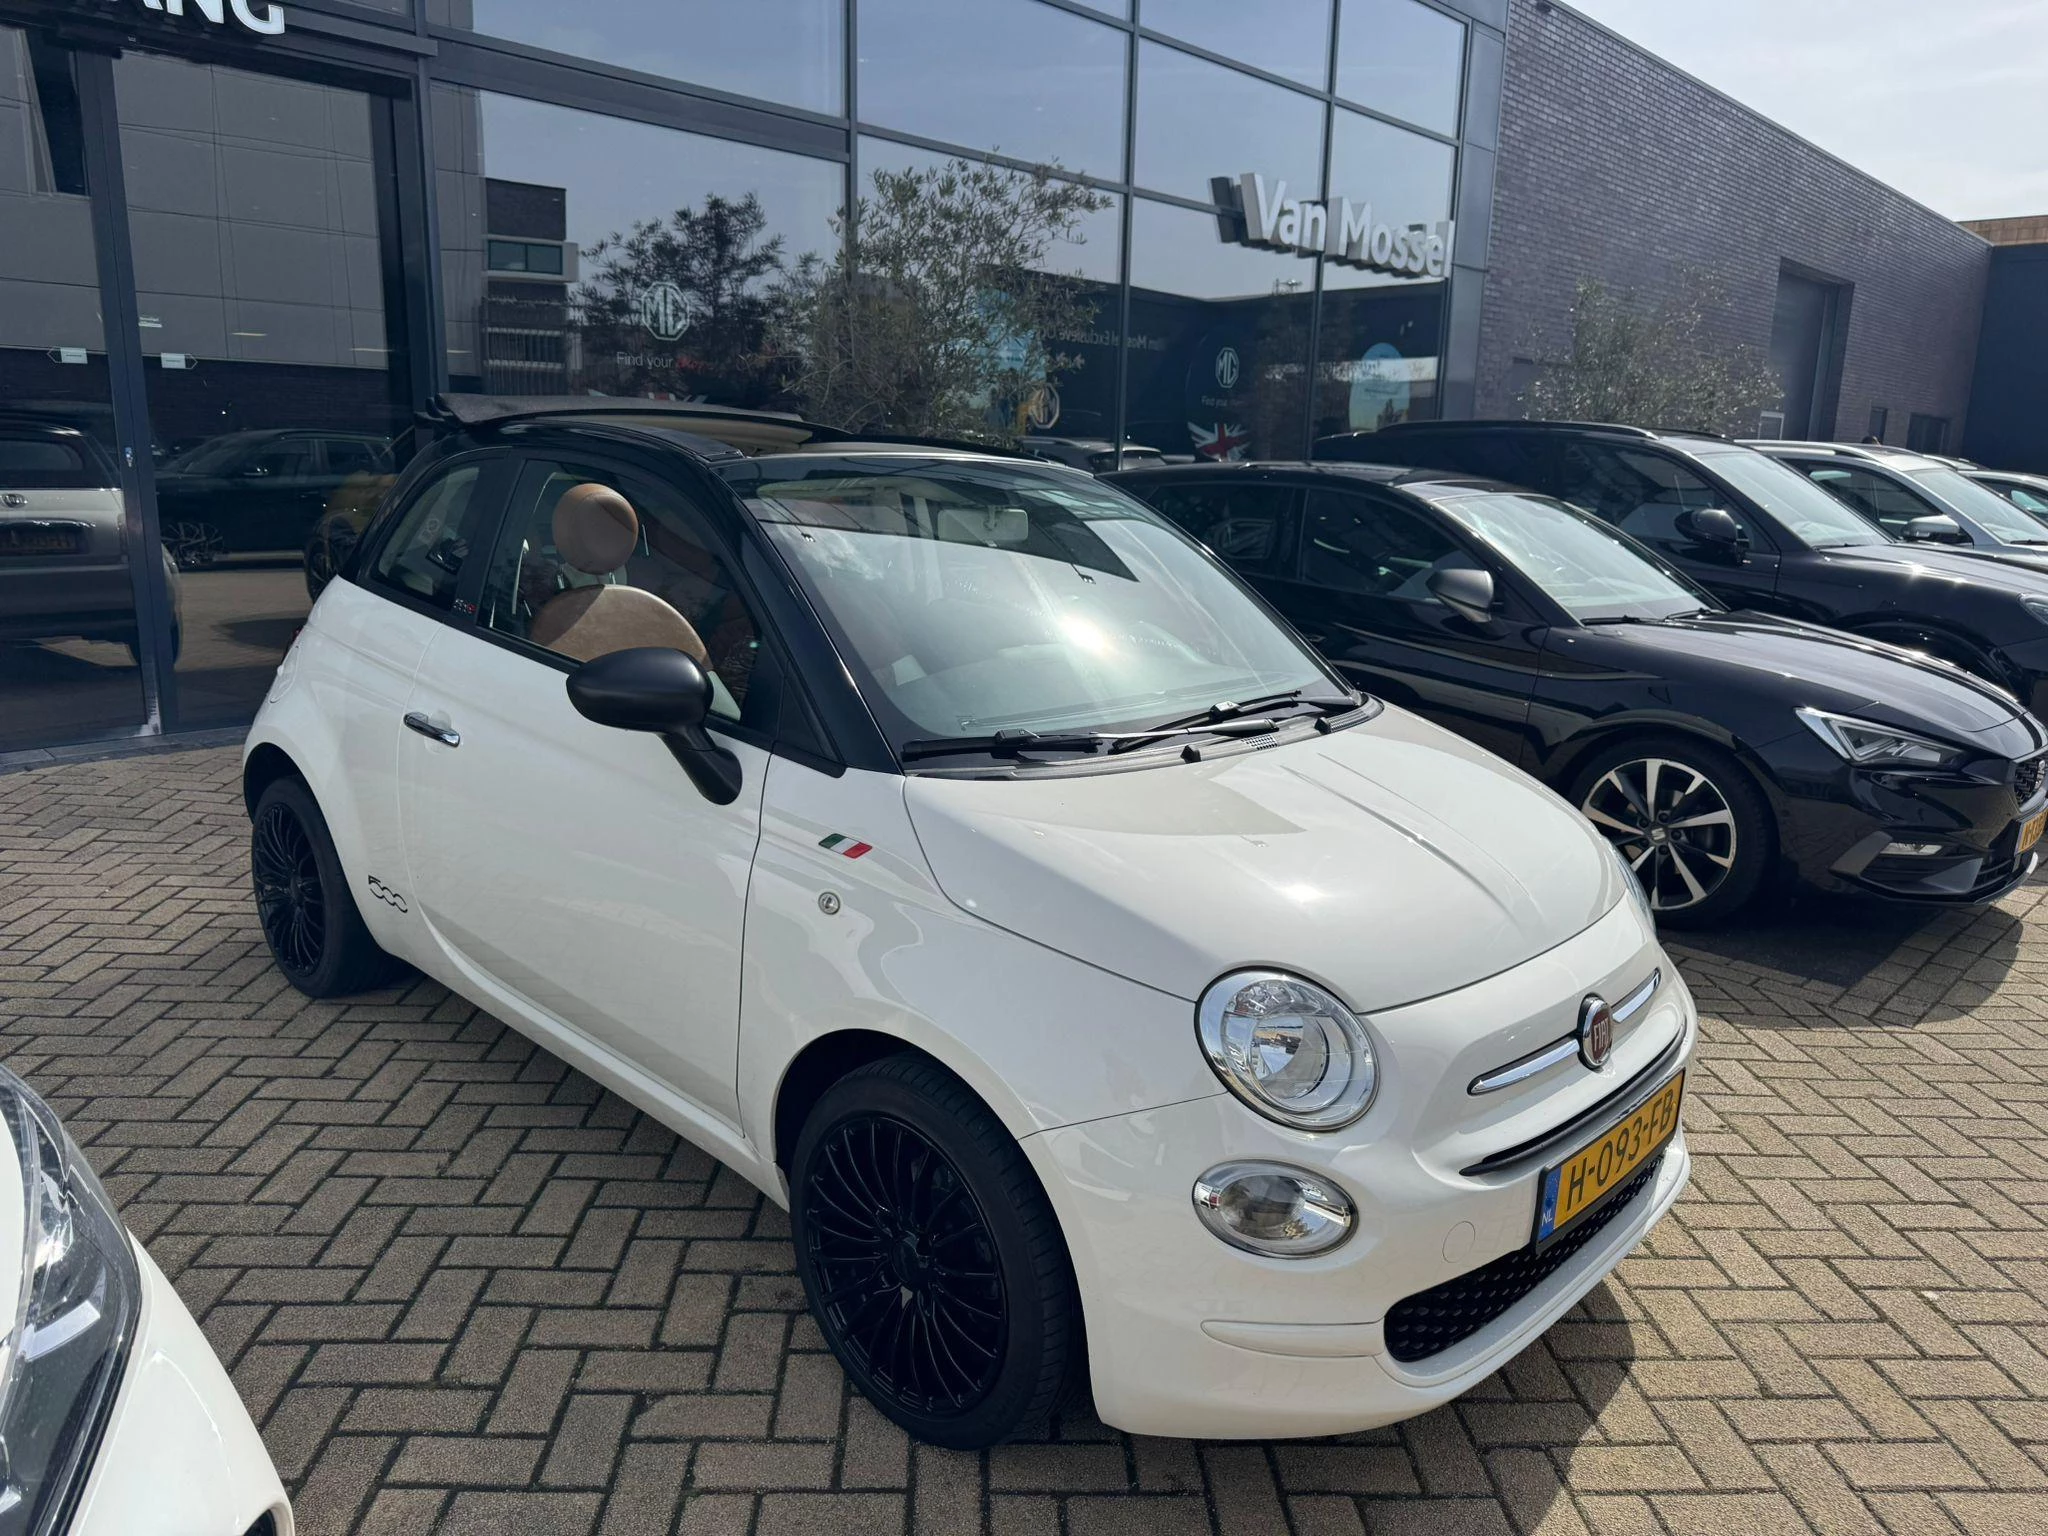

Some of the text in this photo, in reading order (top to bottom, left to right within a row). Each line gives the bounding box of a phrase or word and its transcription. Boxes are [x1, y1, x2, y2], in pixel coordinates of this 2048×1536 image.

[1243, 173, 1455, 277] Van Mossel
[644, 285, 687, 337] MG
[616, 352, 643, 366] Find
[646, 356, 674, 369] your
[1217, 350, 1238, 386] MG
[1593, 1016, 1609, 1052] FIAT
[1566, 1087, 1674, 1212] H-093-FB
[1541, 1212, 1553, 1229] NL
